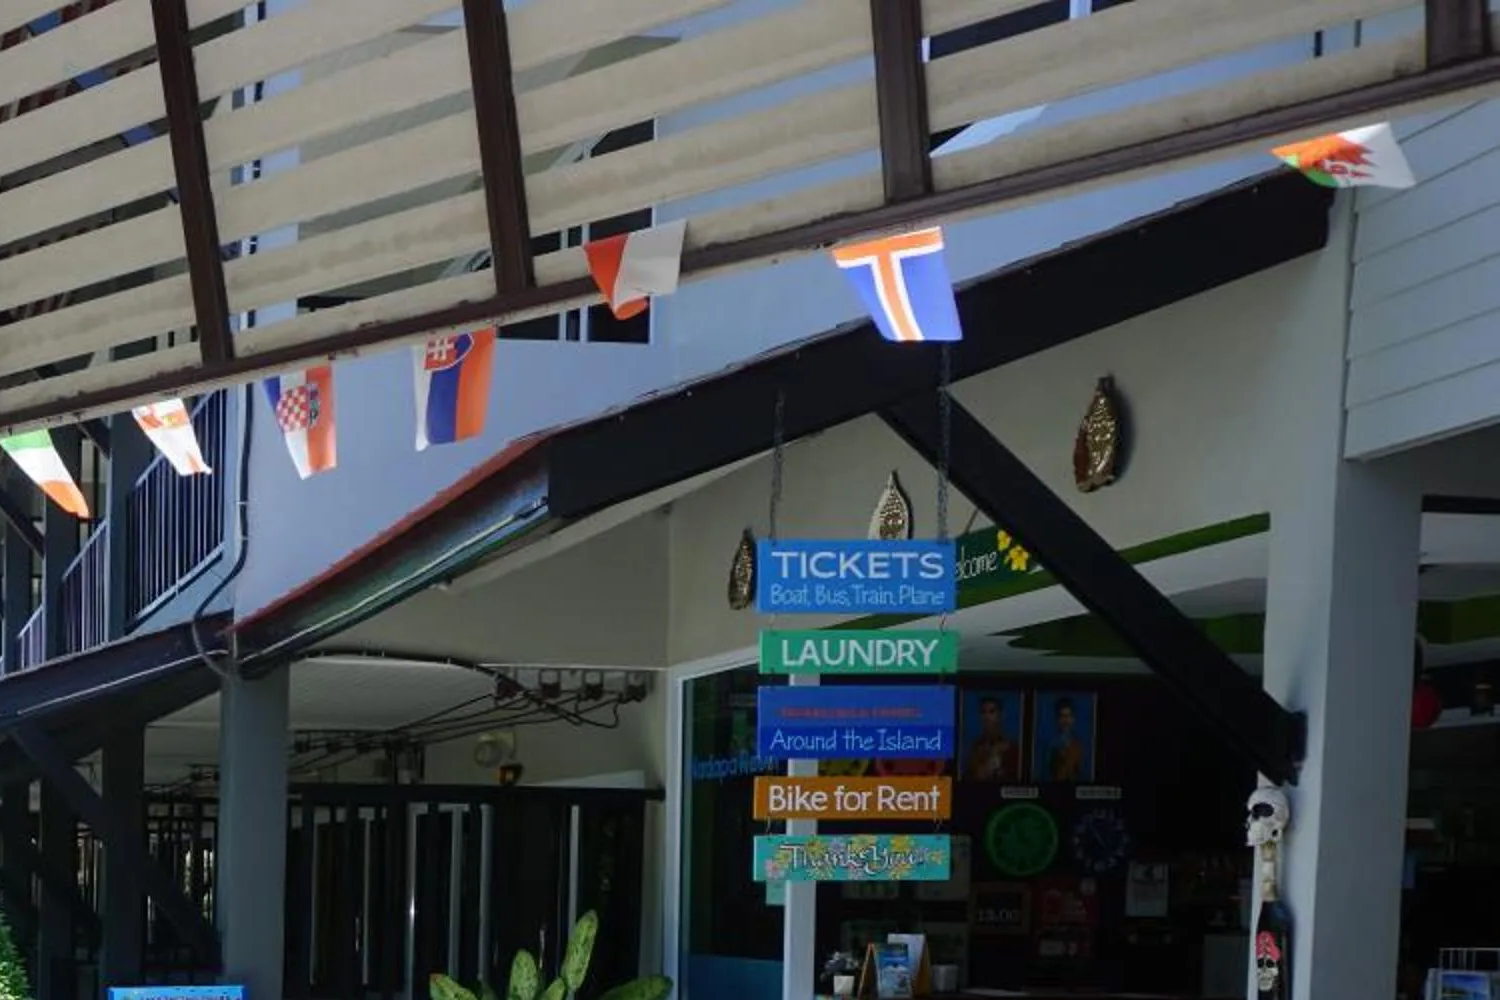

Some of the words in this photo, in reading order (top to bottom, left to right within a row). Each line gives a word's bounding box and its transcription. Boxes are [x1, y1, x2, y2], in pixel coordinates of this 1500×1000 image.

[771, 551, 945, 579] TICKETS
[899, 583, 945, 605] Plane
[781, 639, 939, 667] LAUNDRY
[770, 728, 837, 751] Around
[842, 728, 875, 751] the
[876, 728, 942, 751] Island
[768, 785, 829, 813] Bike
[833, 785, 873, 812] for
[876, 785, 941, 813] Rent
